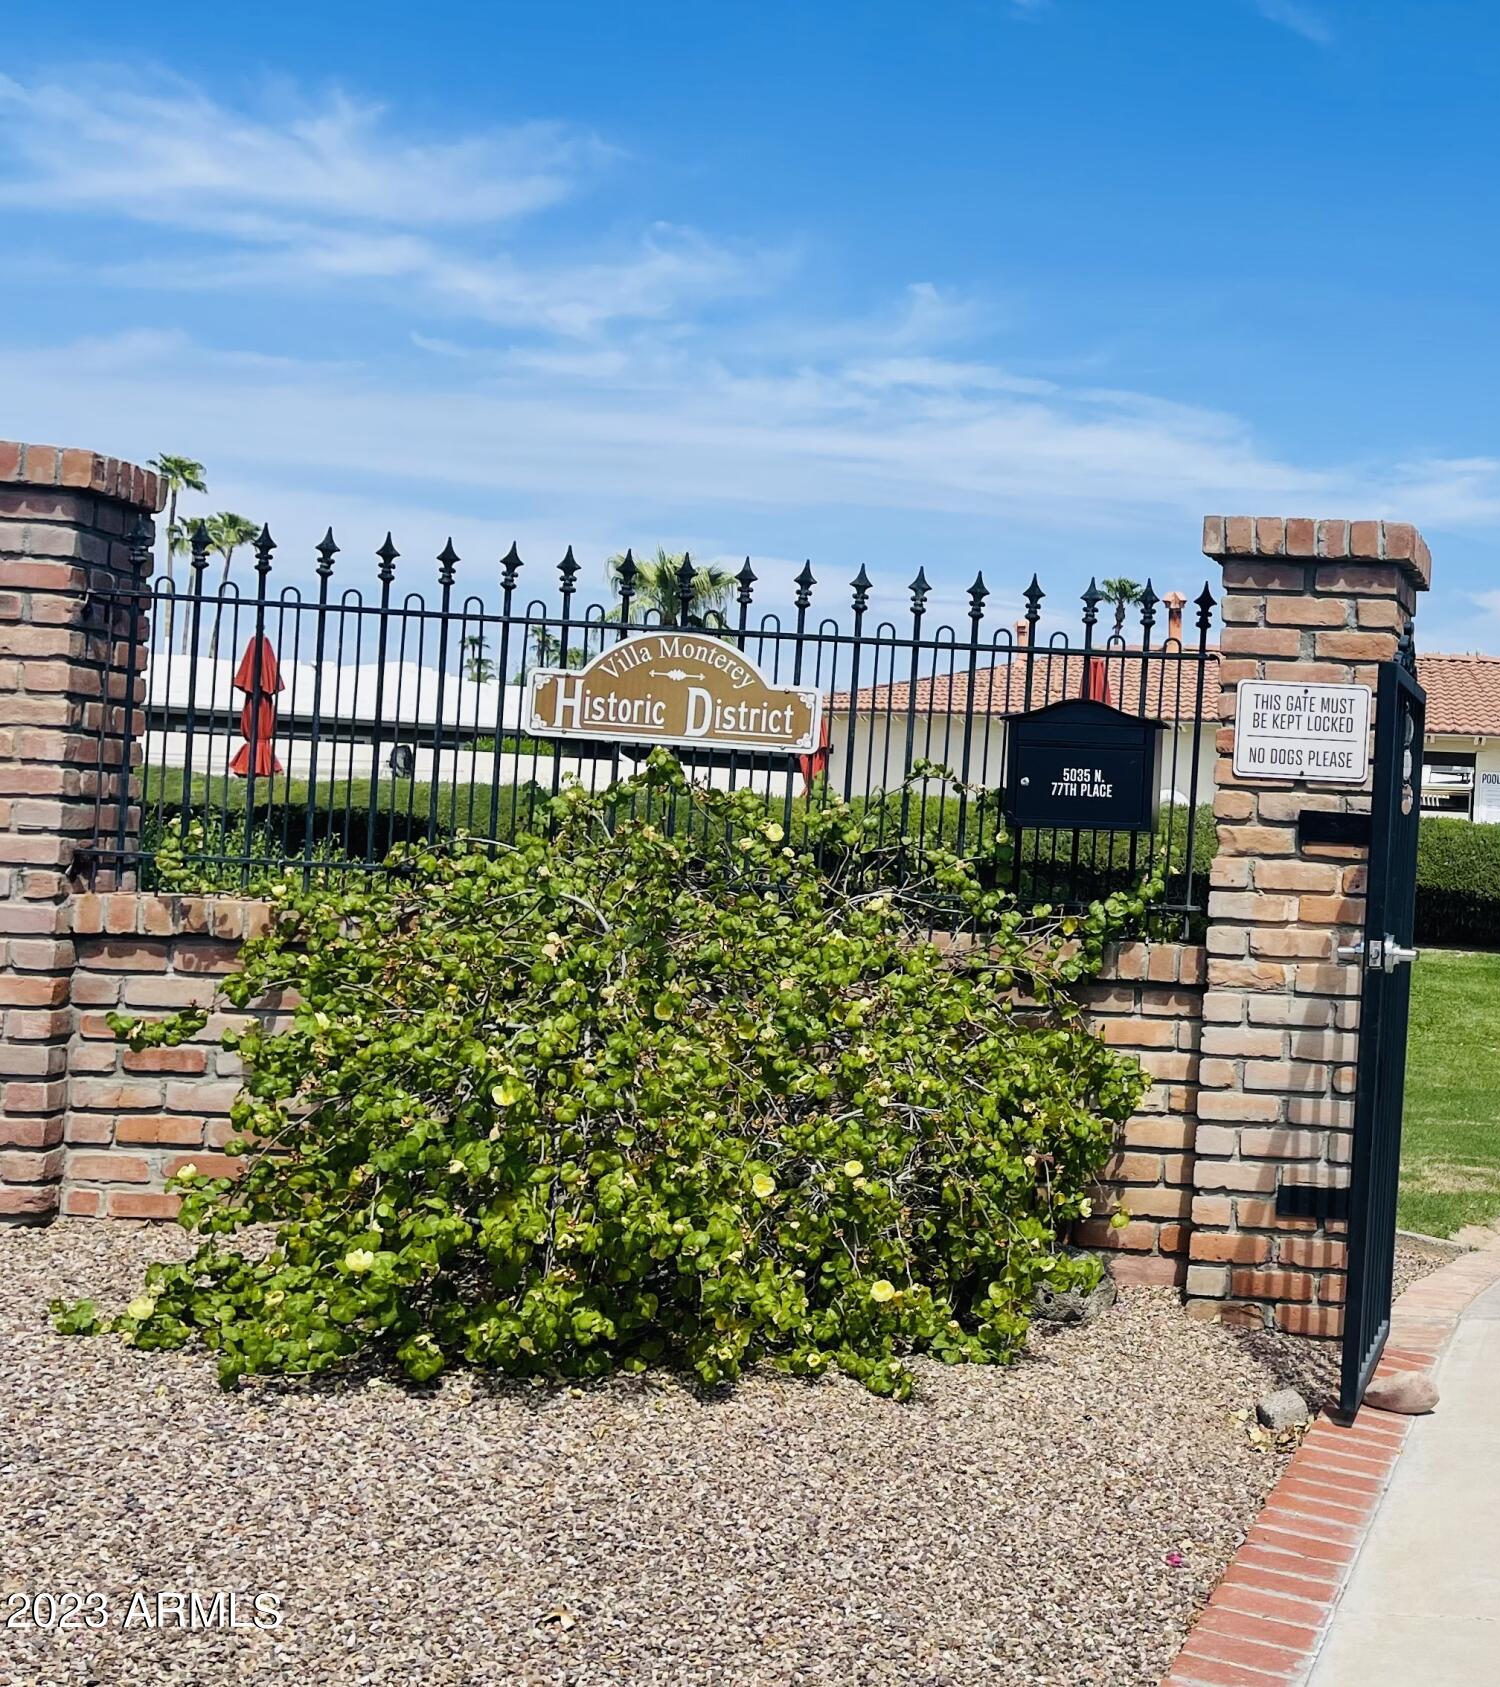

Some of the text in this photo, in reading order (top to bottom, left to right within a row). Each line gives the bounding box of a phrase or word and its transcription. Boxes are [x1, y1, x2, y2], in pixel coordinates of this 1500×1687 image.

[598, 636, 756, 689] Villa Monterey
[552, 676, 795, 738] Historic District
[1253, 693, 1356, 714] THIS GATE MUST
[1252, 712, 1354, 733] BE KEPT LOCKED
[1248, 747, 1353, 768] NO DOGS PLEASE
[1063, 768, 1105, 783] 5035 N.
[1481, 773, 1500, 785] POOL
[1051, 782, 1113, 798] 77TH PLACE
